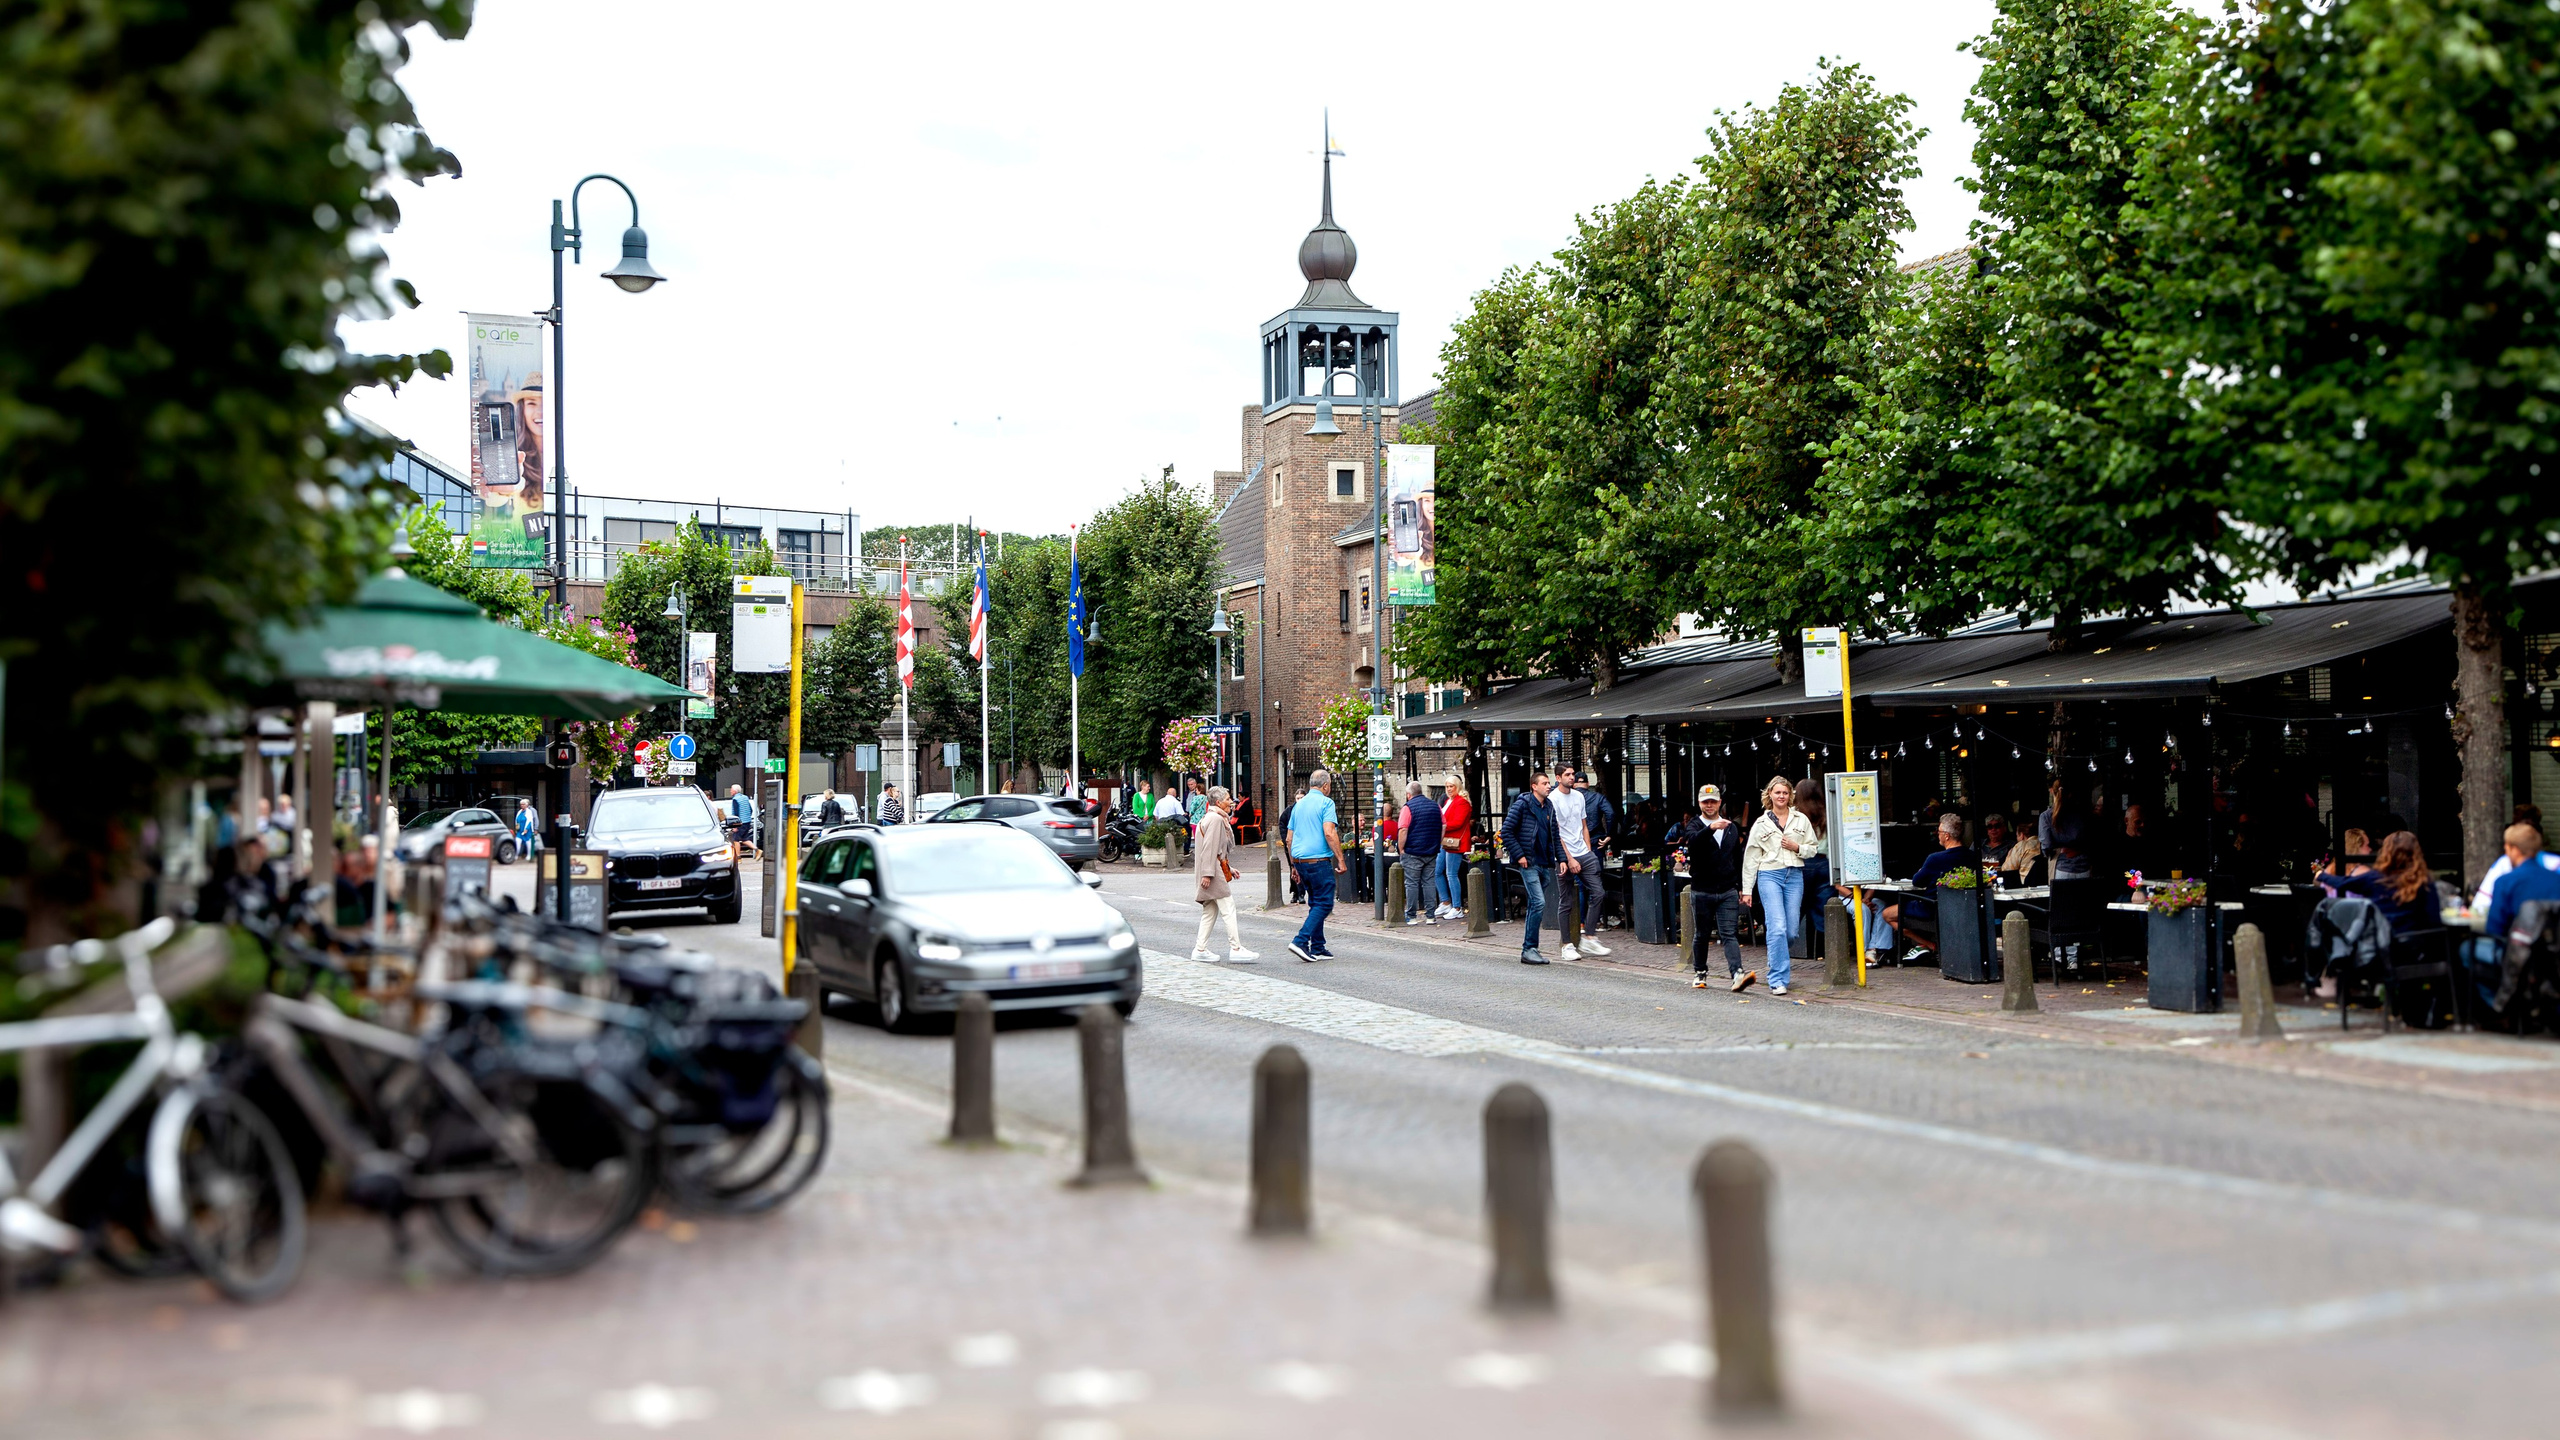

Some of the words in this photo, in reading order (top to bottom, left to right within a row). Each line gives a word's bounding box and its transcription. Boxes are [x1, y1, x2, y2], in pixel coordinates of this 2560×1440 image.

[473, 478, 481, 530] BUITEN
[528, 518, 545, 533] NL
[490, 548, 537, 556] Baarle-Nassau
